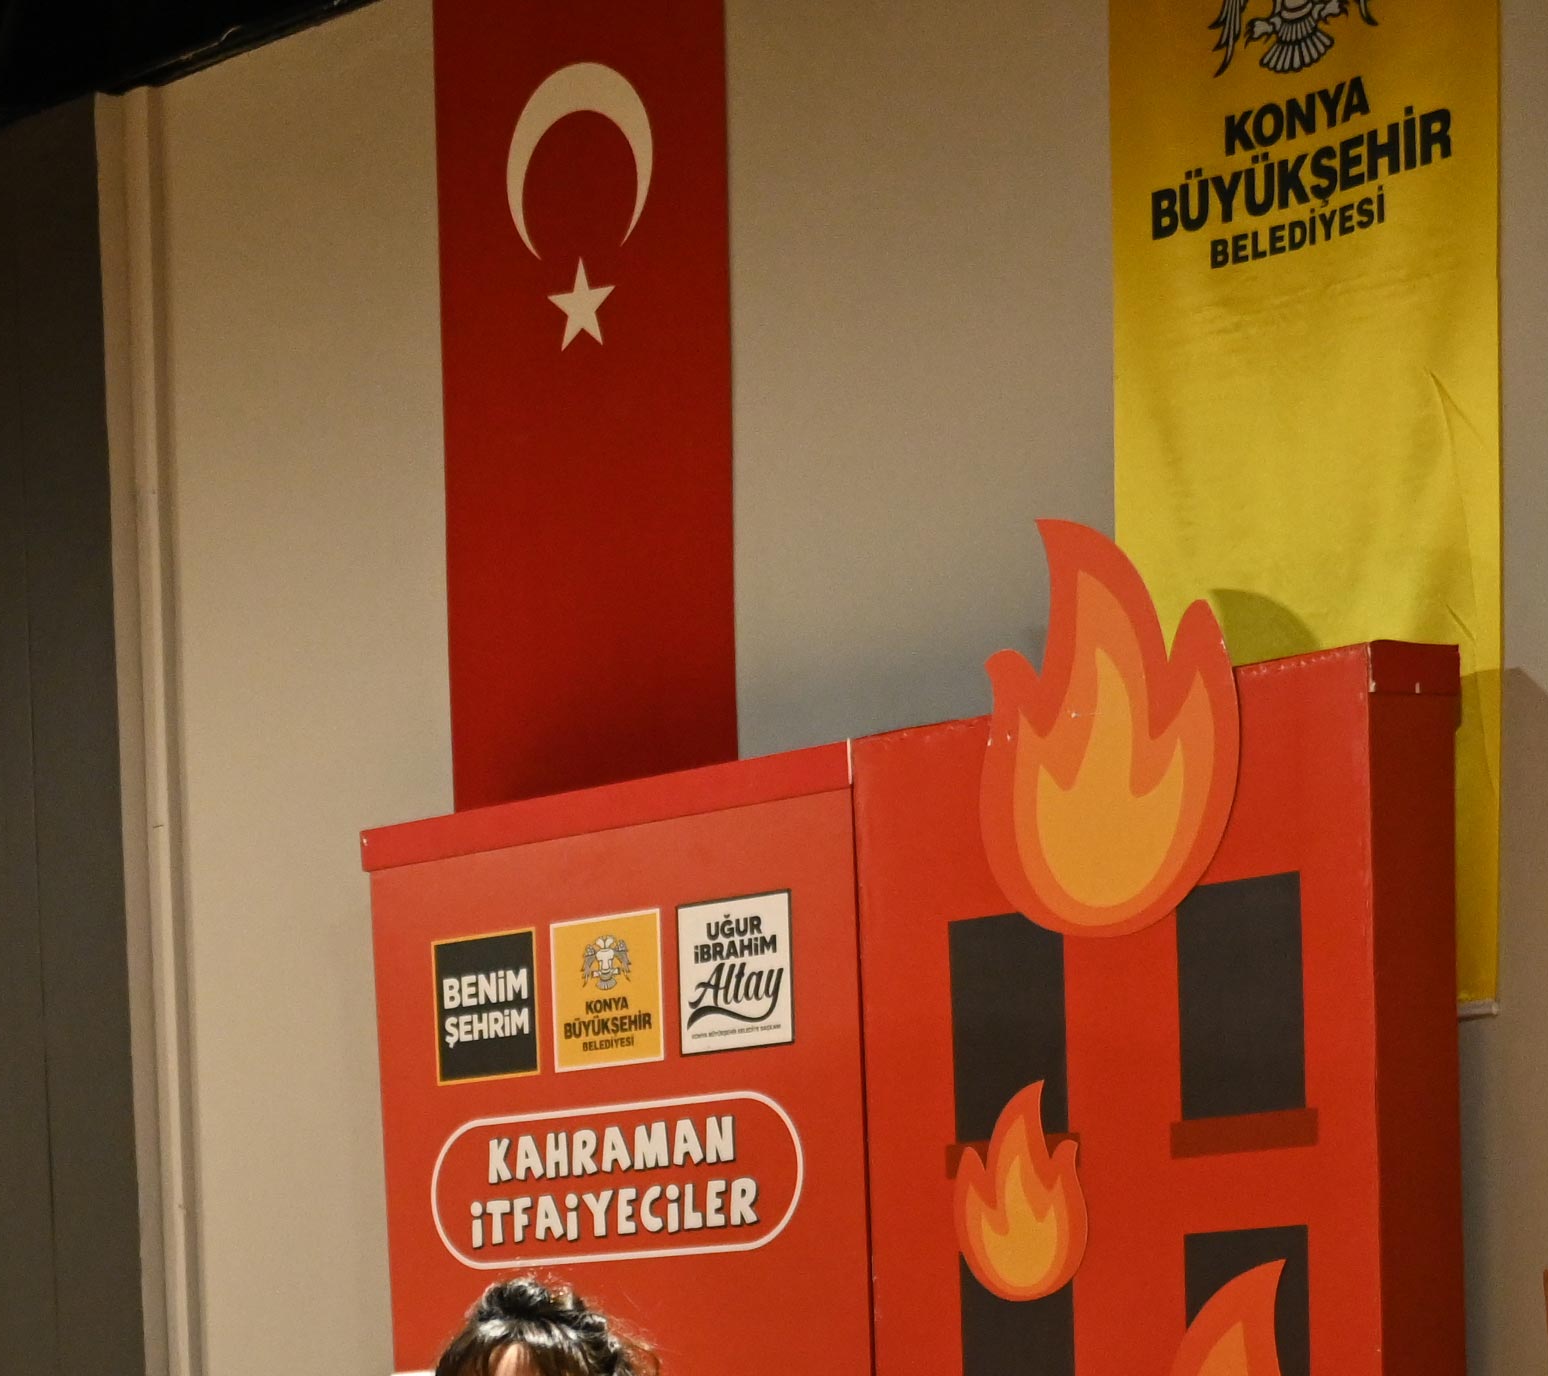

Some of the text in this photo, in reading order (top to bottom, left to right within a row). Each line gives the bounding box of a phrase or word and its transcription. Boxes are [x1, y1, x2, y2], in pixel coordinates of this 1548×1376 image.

[1224, 76, 1370, 156] KONYA
[1151, 105, 1452, 240] BÜYÜKŞEHİR
[1210, 185, 1385, 269] BELEDİYESİ
[706, 914, 761, 941] UĞUR
[693, 934, 778, 964] İBRAHİM
[442, 968, 528, 1010] BENİM
[585, 997, 629, 1015] KONYA
[687, 962, 784, 1026] Altay
[444, 1008, 530, 1049] ŞEHRİM
[563, 1010, 652, 1039] BÜYÜKŞEHİR
[582, 1034, 635, 1052] BELEDİYESİ
[488, 1115, 735, 1184] KAHRAMAN
[470, 1177, 759, 1249] İTFAİYECİLER
